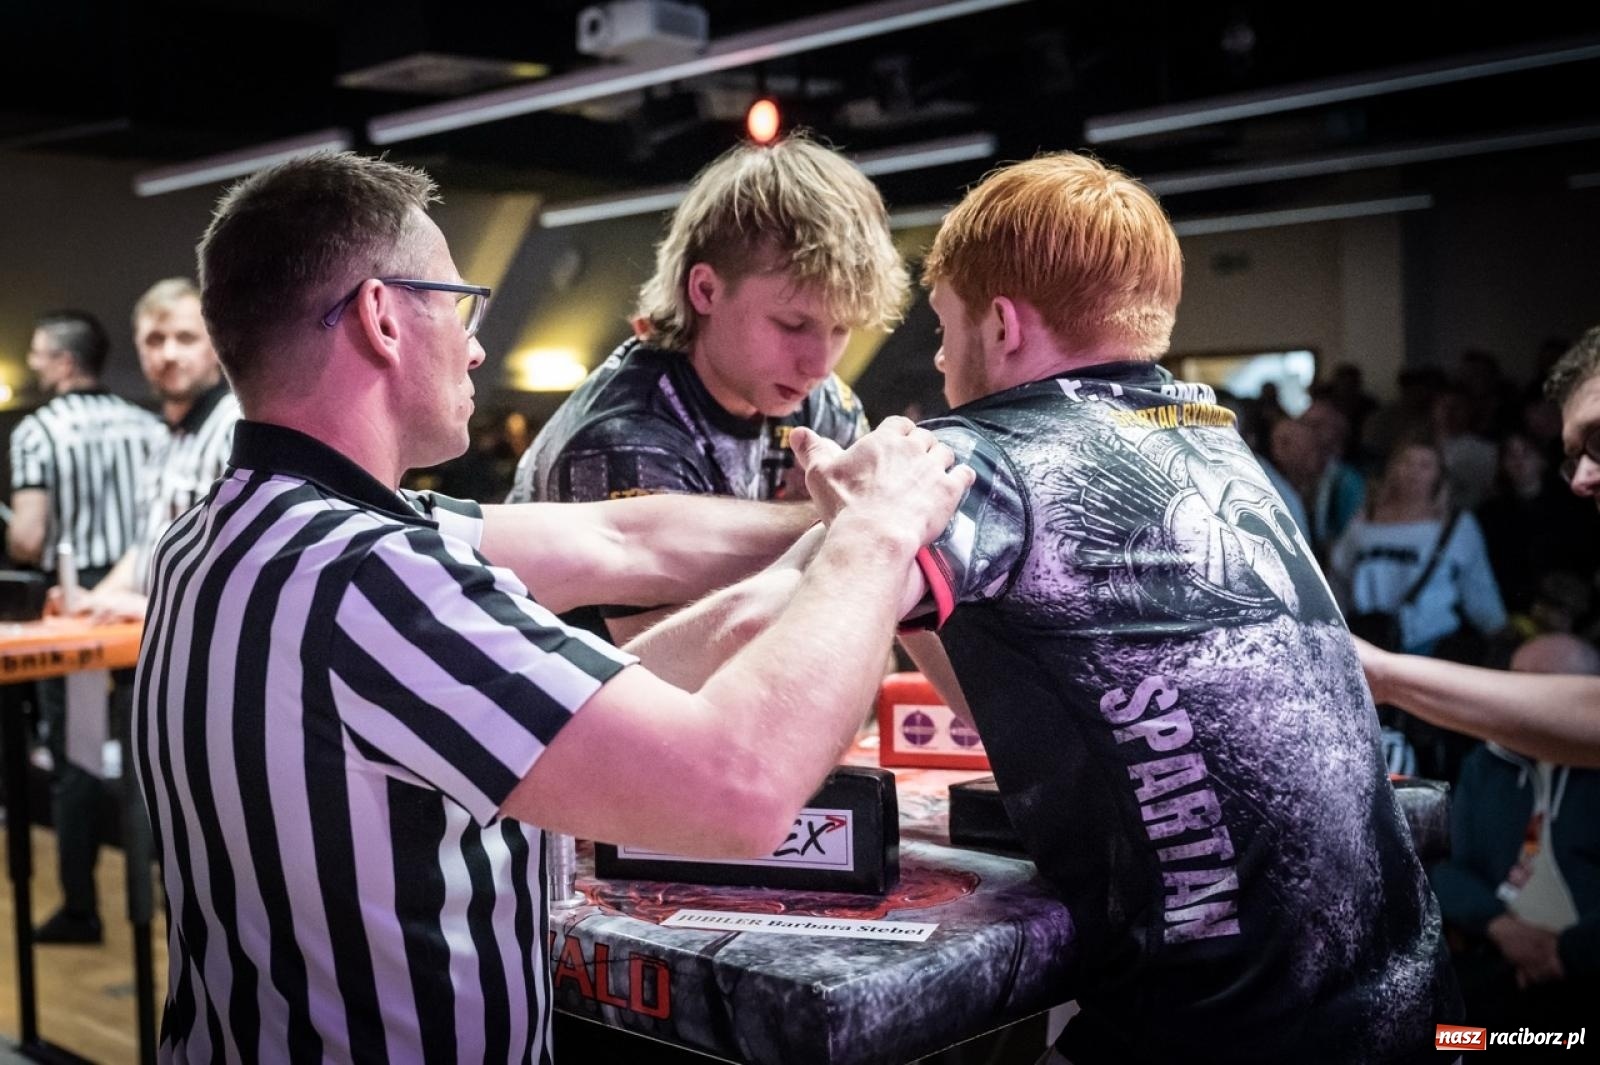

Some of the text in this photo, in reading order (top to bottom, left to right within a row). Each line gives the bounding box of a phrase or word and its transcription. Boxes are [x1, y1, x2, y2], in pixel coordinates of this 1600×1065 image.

[1099, 674, 1241, 944] SPARTAN
[678, 914, 926, 937] JUBILER Barbara Stebel
